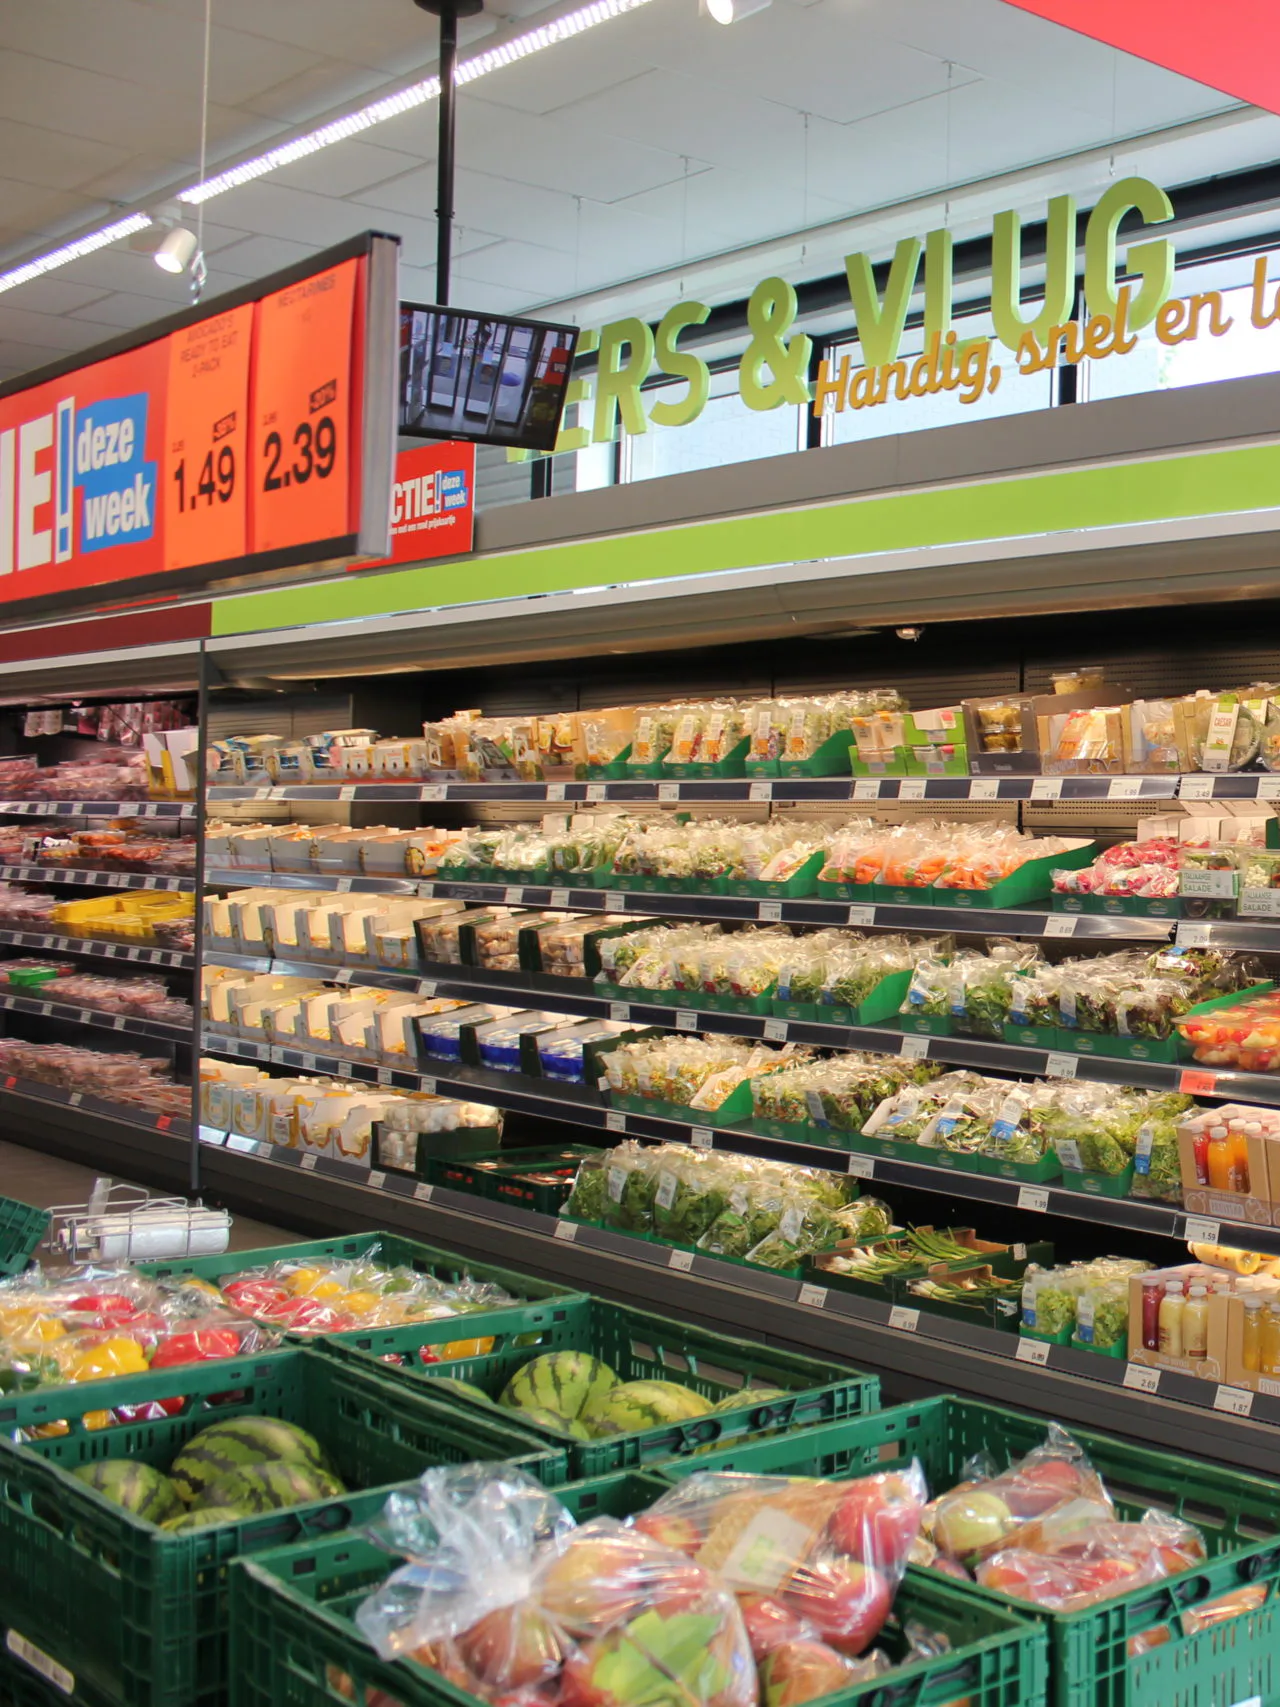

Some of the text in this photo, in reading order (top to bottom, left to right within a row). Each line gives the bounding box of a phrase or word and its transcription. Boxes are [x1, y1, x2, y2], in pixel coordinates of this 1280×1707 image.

[515, 300, 711, 460] ERS
[739, 276, 813, 412] &
[812, 330, 1001, 418] Handig,
[1016, 284, 1139, 374] snel
[1154, 291, 1234, 346] en
[77, 413, 135, 474] deze
[263, 416, 337, 493] 2.39
[84, 474, 151, 540] week
[174, 444, 235, 514] 1.49
[390, 470, 442, 524] CTIE!
[1184, 883, 1212, 892] SALADE
[1243, 902, 1272, 911] SALADE
[1202, 1231, 1216, 1240] 1.59
